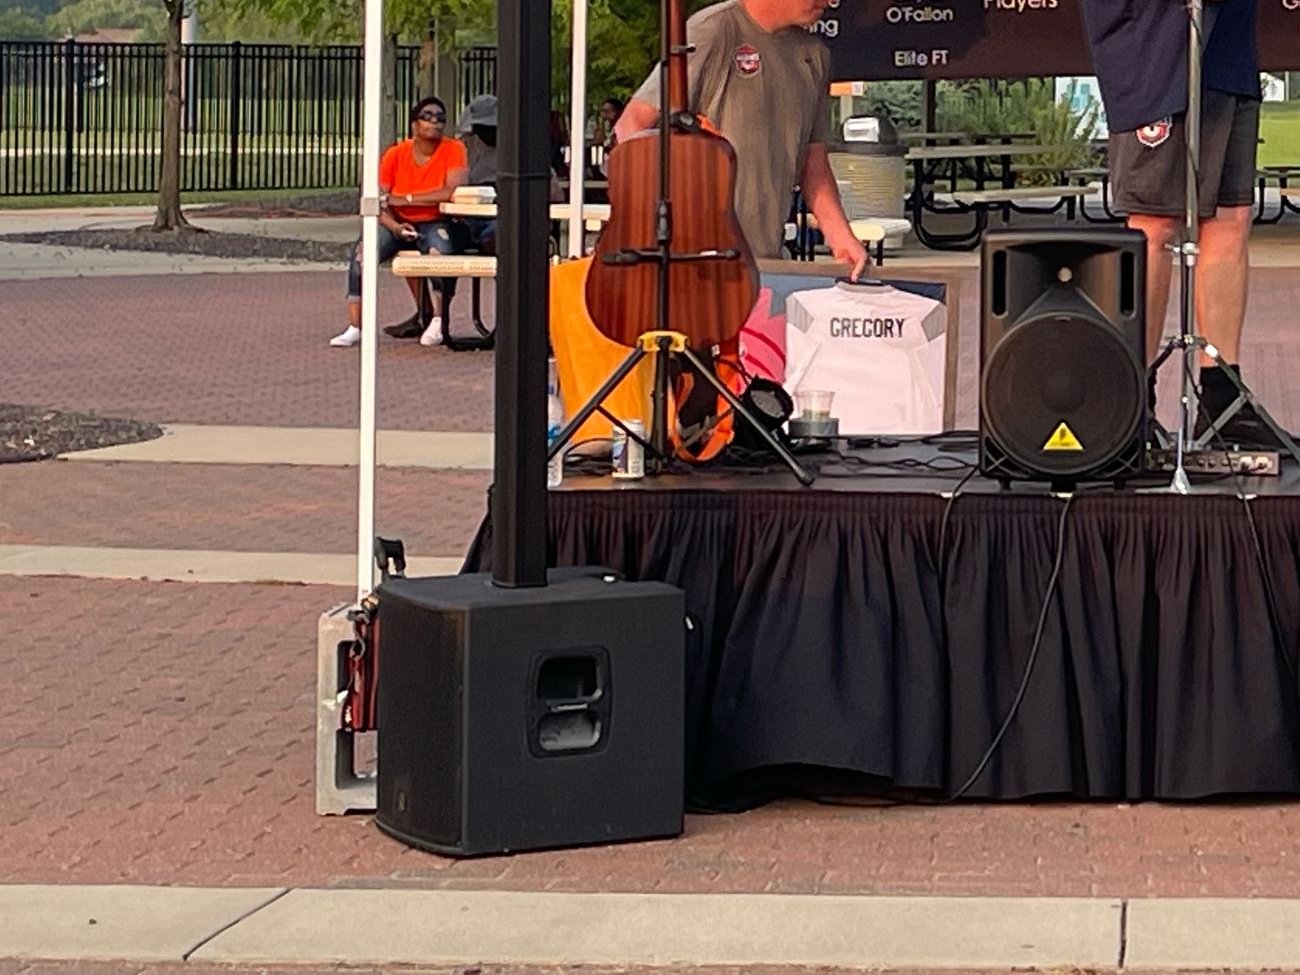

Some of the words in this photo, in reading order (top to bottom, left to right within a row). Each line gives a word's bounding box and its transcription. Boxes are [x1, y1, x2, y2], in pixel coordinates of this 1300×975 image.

[895, 50, 928, 66] Elite
[932, 49, 949, 65] FT
[830, 317, 904, 338] GREGORY
